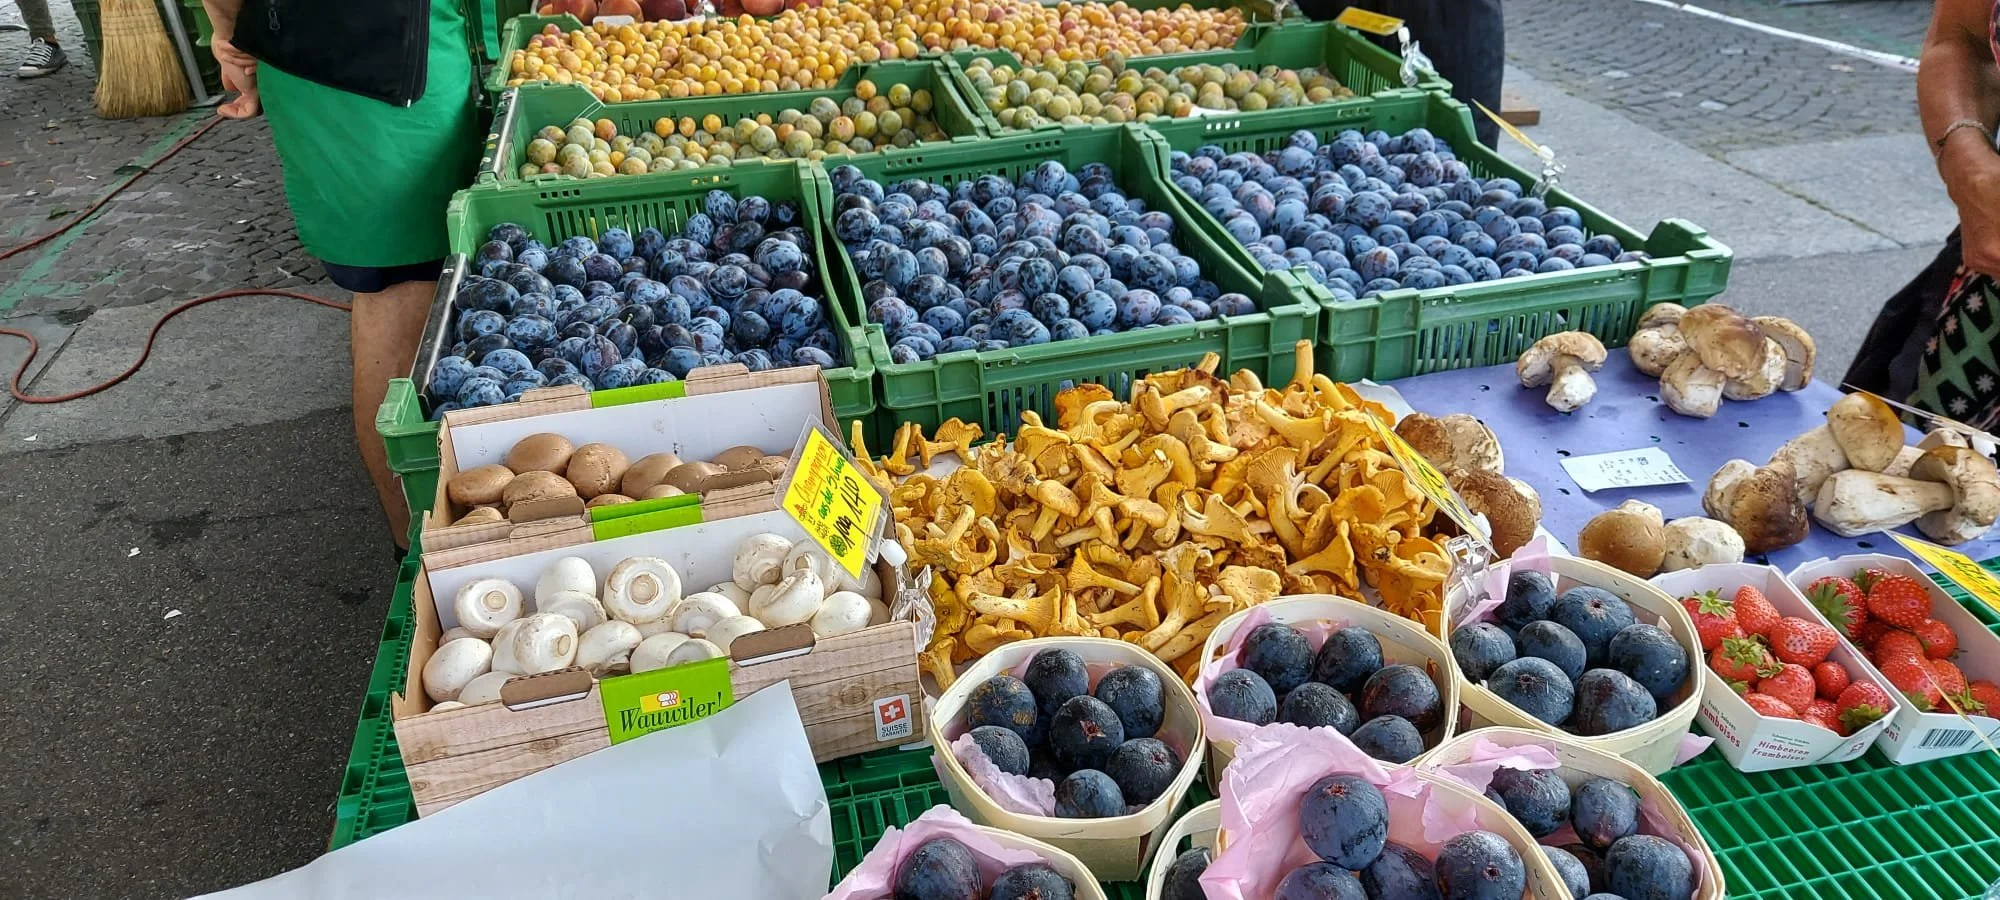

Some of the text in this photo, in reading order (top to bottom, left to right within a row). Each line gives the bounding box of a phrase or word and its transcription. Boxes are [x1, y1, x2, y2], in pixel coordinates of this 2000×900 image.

[618, 691, 722, 733] Wauwiler!
[881, 722, 909, 733] SUISSE
[1701, 704, 1741, 747] ramboises
[881, 729, 909, 738] GARANTIE
[1752, 748, 1806, 761] Framboises
[1758, 740, 1810, 755] Himbeeren
